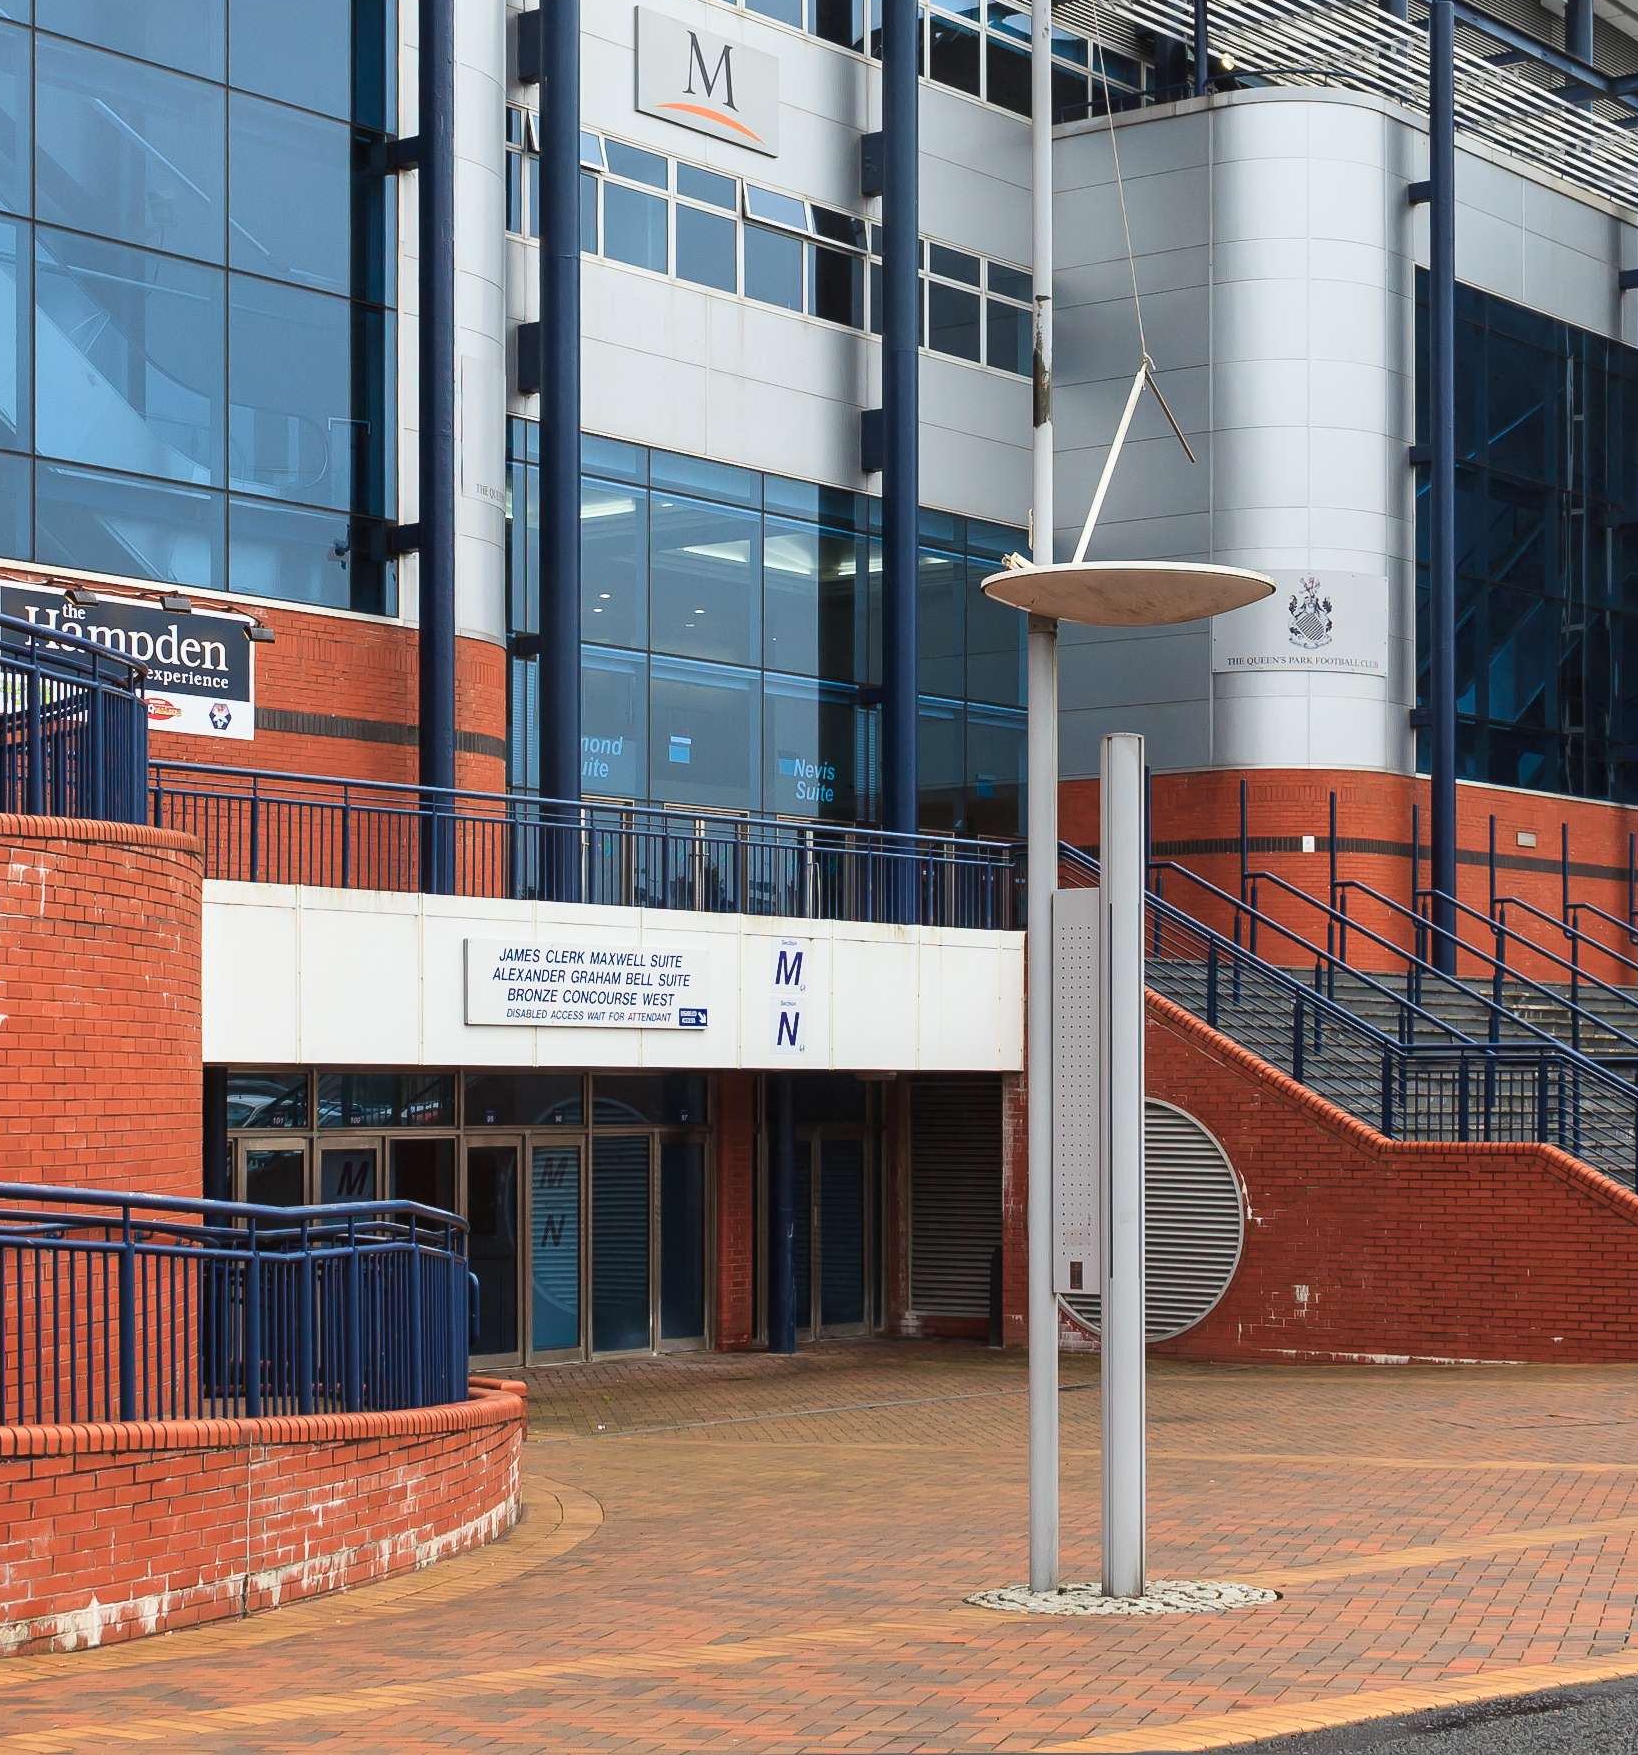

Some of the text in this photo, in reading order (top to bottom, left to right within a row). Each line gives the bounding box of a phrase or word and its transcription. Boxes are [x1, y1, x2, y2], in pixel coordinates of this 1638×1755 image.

[682, 30, 739, 112] M
[62, 603, 86, 620] the
[25, 606, 229, 672] Hampden
[1227, 657, 1244, 665] THE
[1246, 656, 1286, 665] QUEEN'S
[1289, 656, 1313, 665] PARK
[1315, 657, 1360, 667] FOOTBALL
[146, 668, 229, 689] experience
[793, 759, 835, 780] Nevis
[795, 781, 834, 802] Suite
[499, 948, 683, 968] JAMES CLERK MAXWELL SUITE
[775, 950, 803, 985] M
[492, 967, 691, 987] ALEXANDER GRAHAM BELL SUITE
[507, 988, 675, 1007] BRONZE CONCOURSE WEST
[506, 1008, 548, 1019] DISABLED
[551, 1010, 584, 1020] ACCESS
[587, 1011, 606, 1021] WAIT
[608, 1012, 625, 1021] FOR
[627, 1012, 672, 1022] ATTENDANT
[776, 1011, 800, 1046] N
[337, 1161, 369, 1196] M
